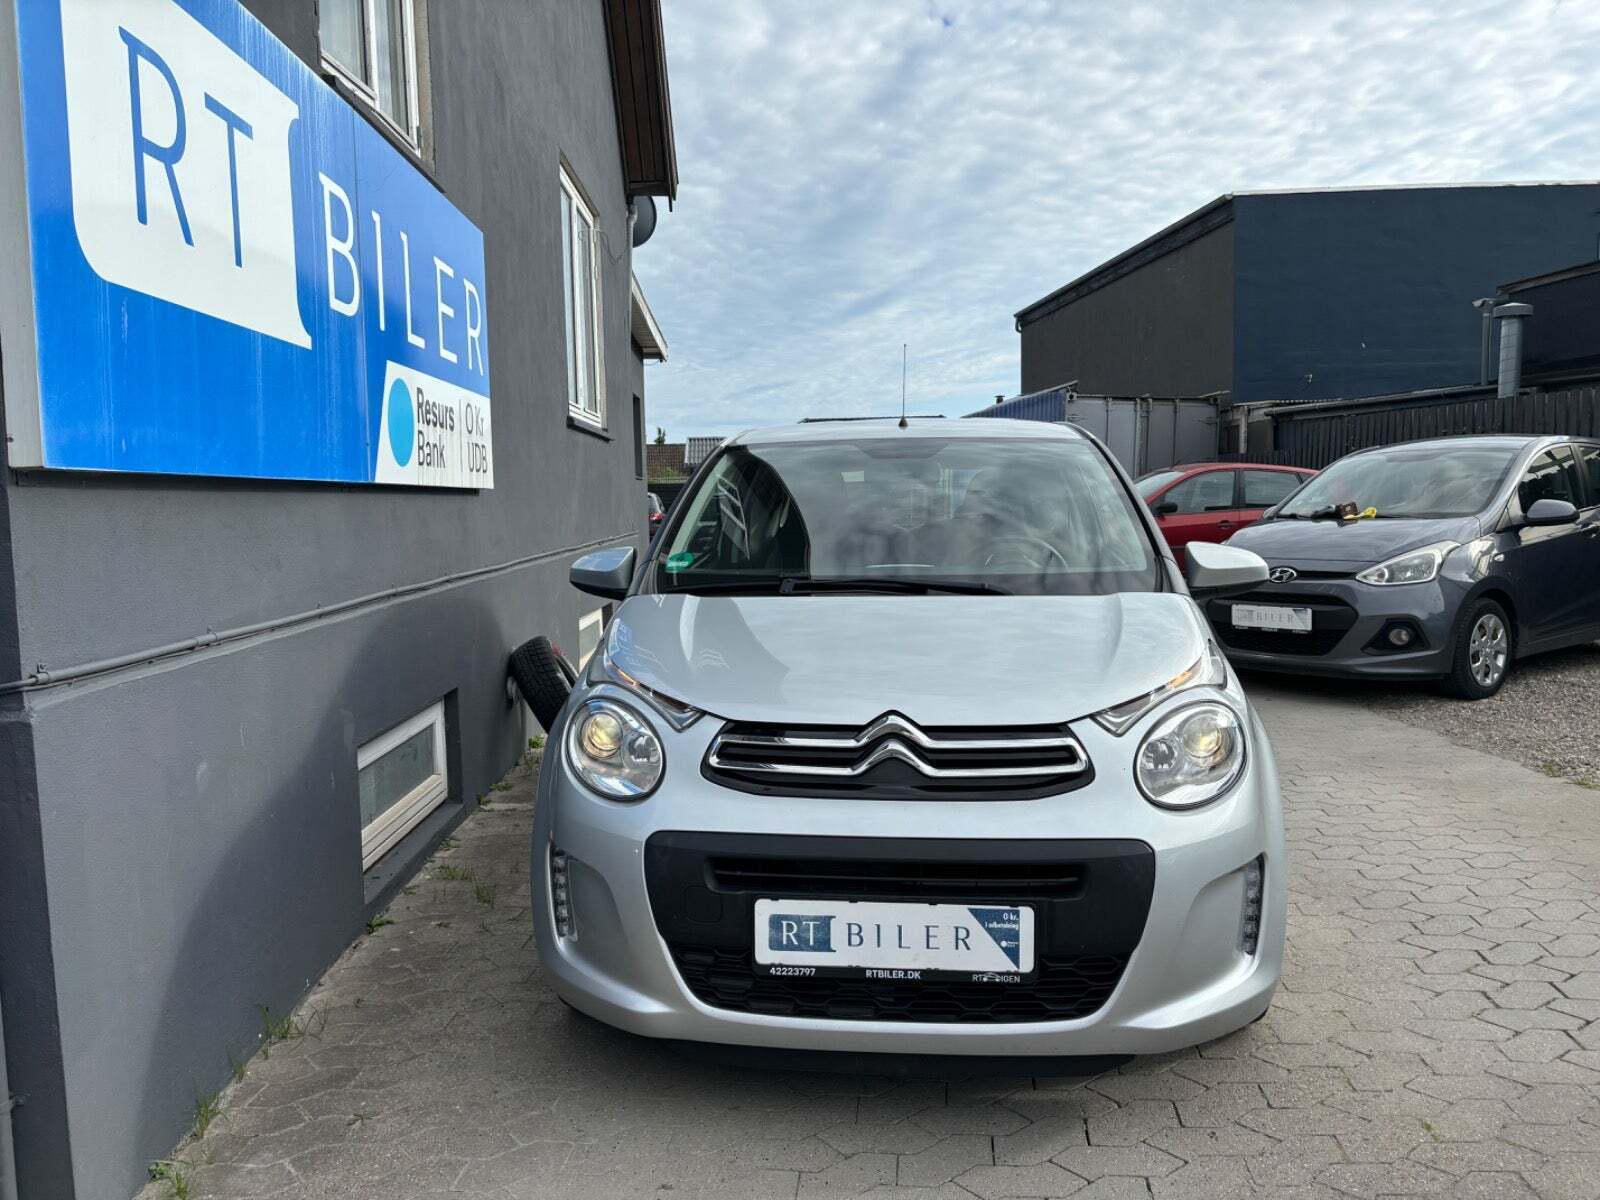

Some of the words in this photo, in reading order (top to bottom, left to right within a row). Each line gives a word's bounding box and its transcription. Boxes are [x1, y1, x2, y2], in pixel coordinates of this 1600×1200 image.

[118, 25, 254, 270] RT
[319, 171, 485, 377] BILER
[416, 386, 455, 432] Resurs
[417, 429, 446, 469] Bank
[466, 441, 488, 474] UDB
[781, 920, 821, 946] RT
[846, 922, 972, 951] BILER
[769, 967, 816, 976] 42223797
[865, 969, 921, 979] RTBILER.DK
